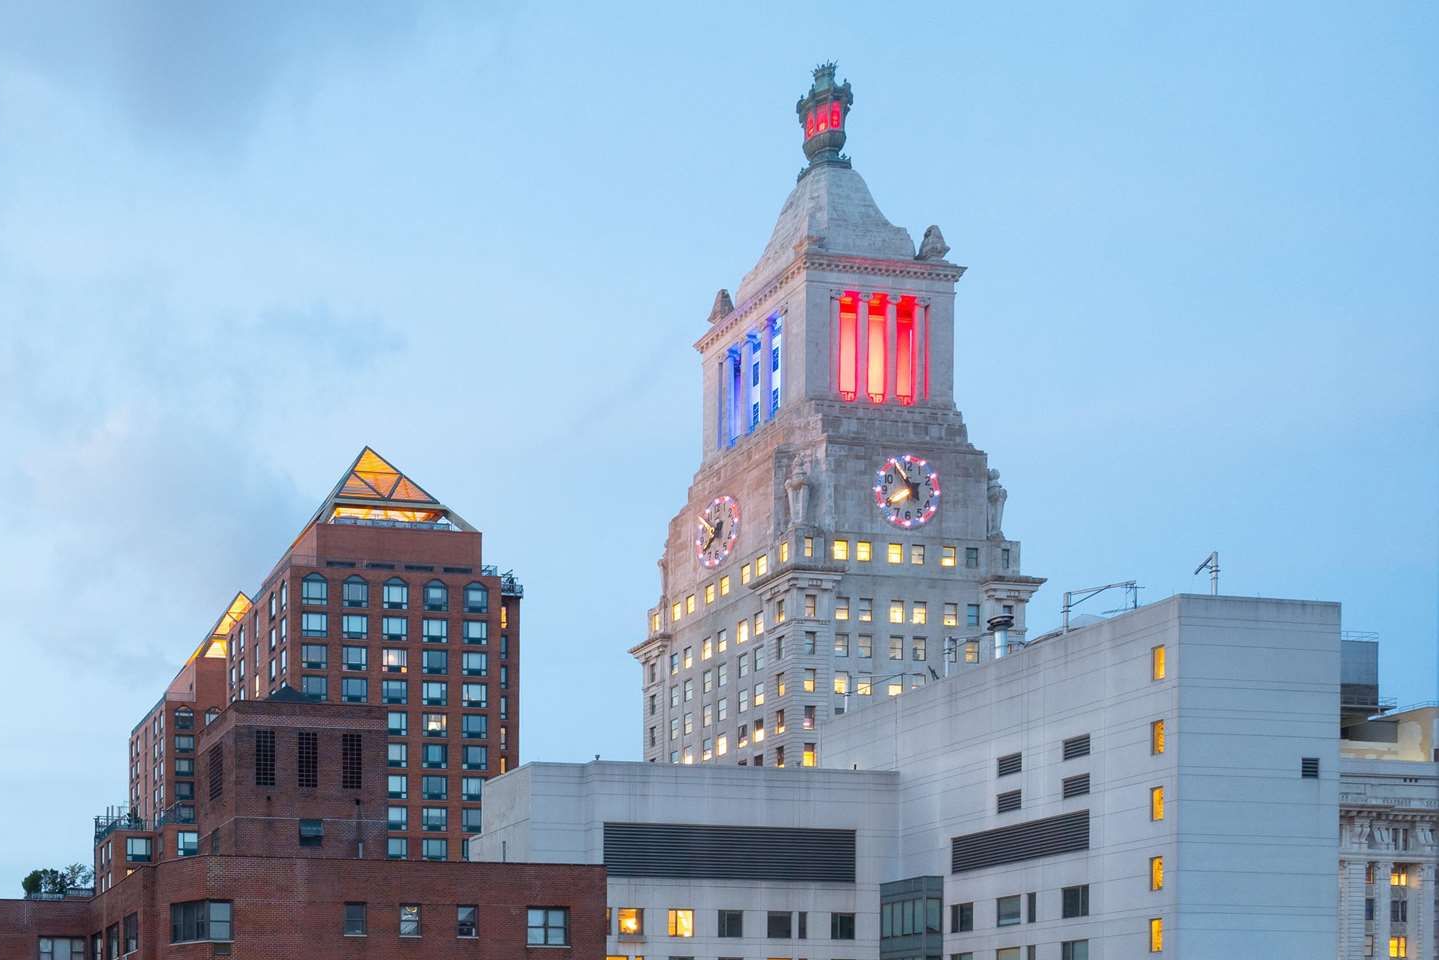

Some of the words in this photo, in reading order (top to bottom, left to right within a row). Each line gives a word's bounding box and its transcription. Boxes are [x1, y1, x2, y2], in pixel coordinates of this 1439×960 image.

[904, 461, 913, 472] 12
[884, 474, 893, 485] 10
[925, 476, 931, 486] 2
[881, 485, 888, 495] 9
[929, 487, 935, 498] 3
[924, 500, 930, 509] 4
[894, 507, 900, 518] 7
[904, 510, 912, 521] 6
[916, 508, 923, 518] 5
